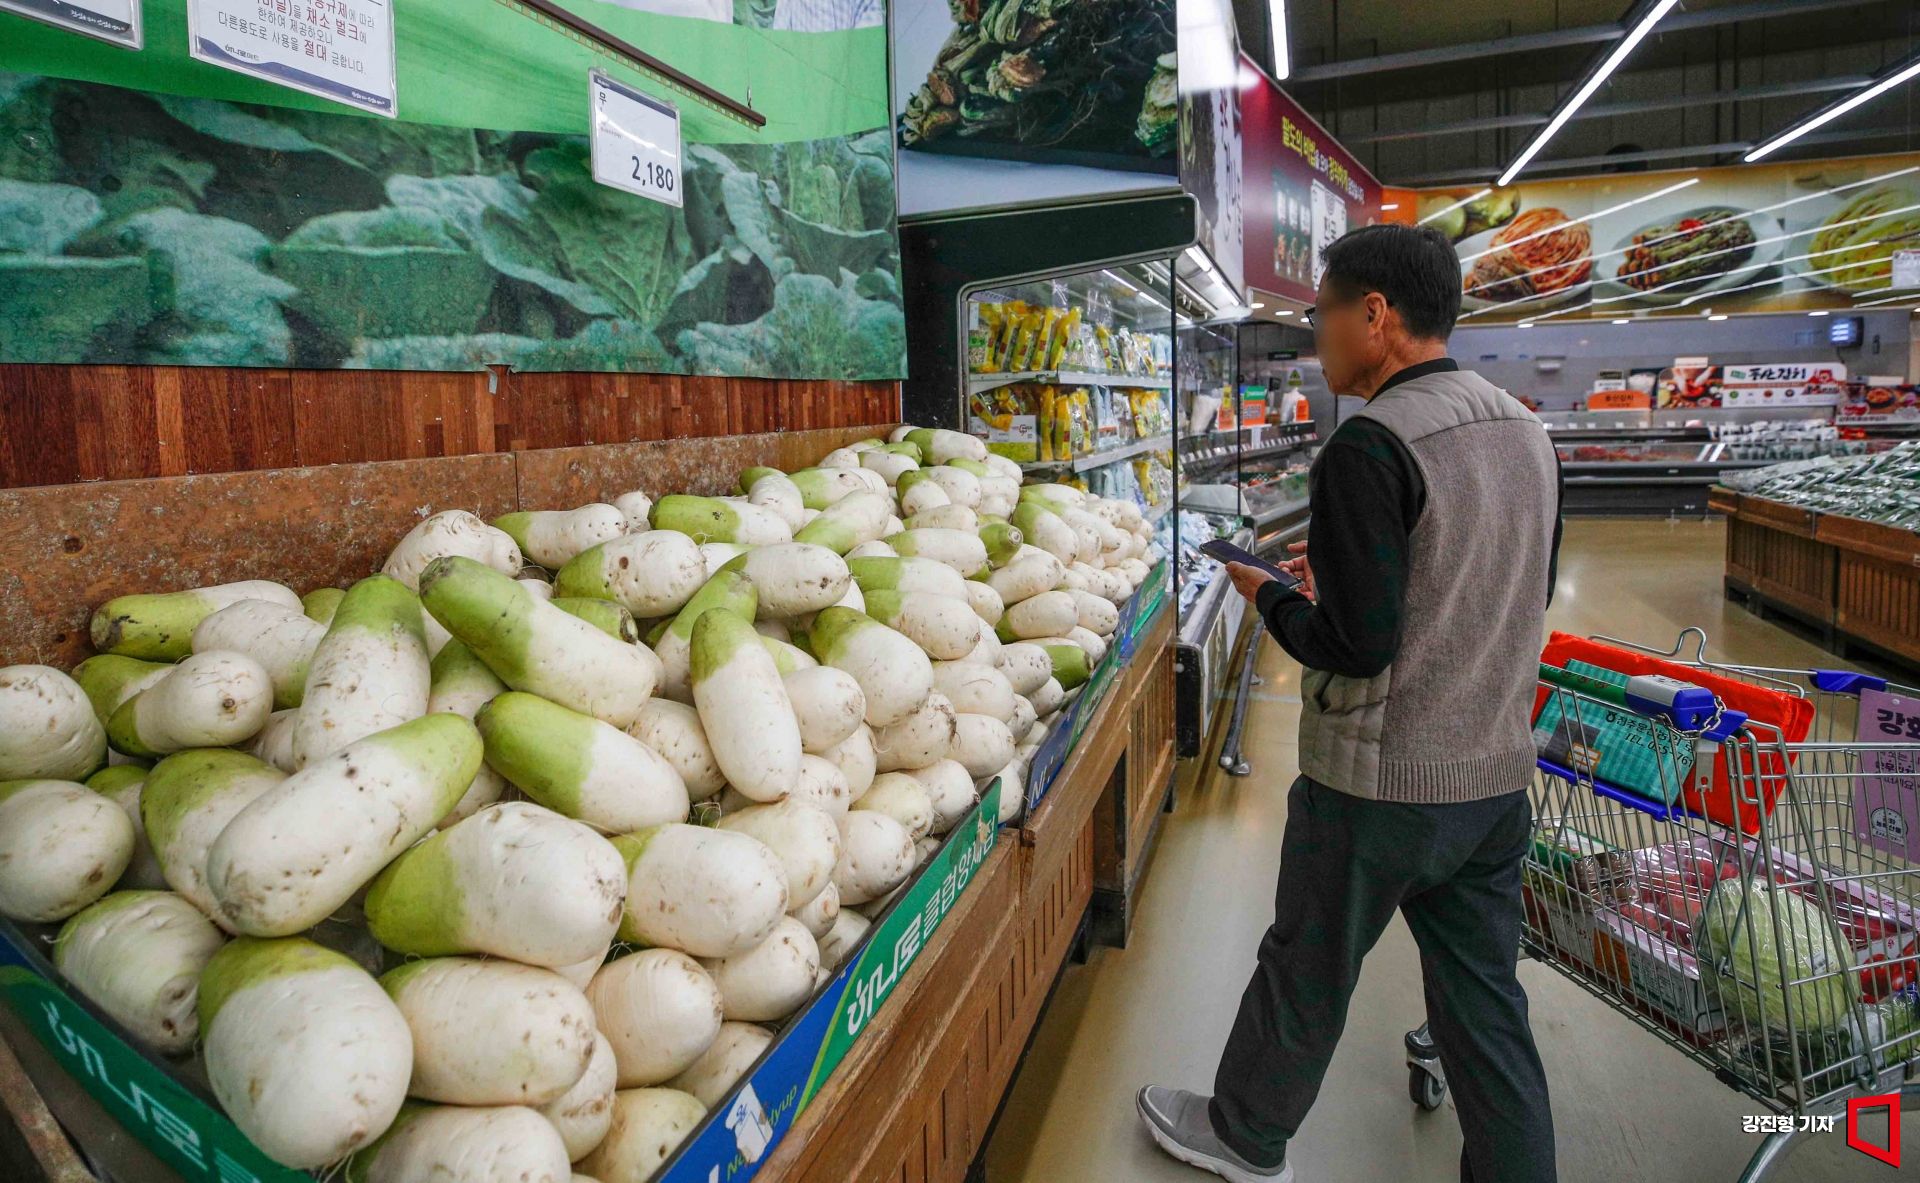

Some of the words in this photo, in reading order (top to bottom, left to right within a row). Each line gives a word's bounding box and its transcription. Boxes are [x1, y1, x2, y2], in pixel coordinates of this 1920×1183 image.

[257, 8, 286, 29] 한하여
[289, 18, 333, 46] 제공하오니
[306, 6, 330, 30] 채소
[335, 18, 367, 44] 벌크에
[359, 13, 375, 29] 따라
[218, 11, 268, 40] 다른용도로
[271, 32, 299, 52] 사용을
[304, 39, 327, 61] 절대
[331, 51, 366, 75] 금합니다.
[599, 91, 607, 105] 무
[631, 155, 674, 192] 2,180
